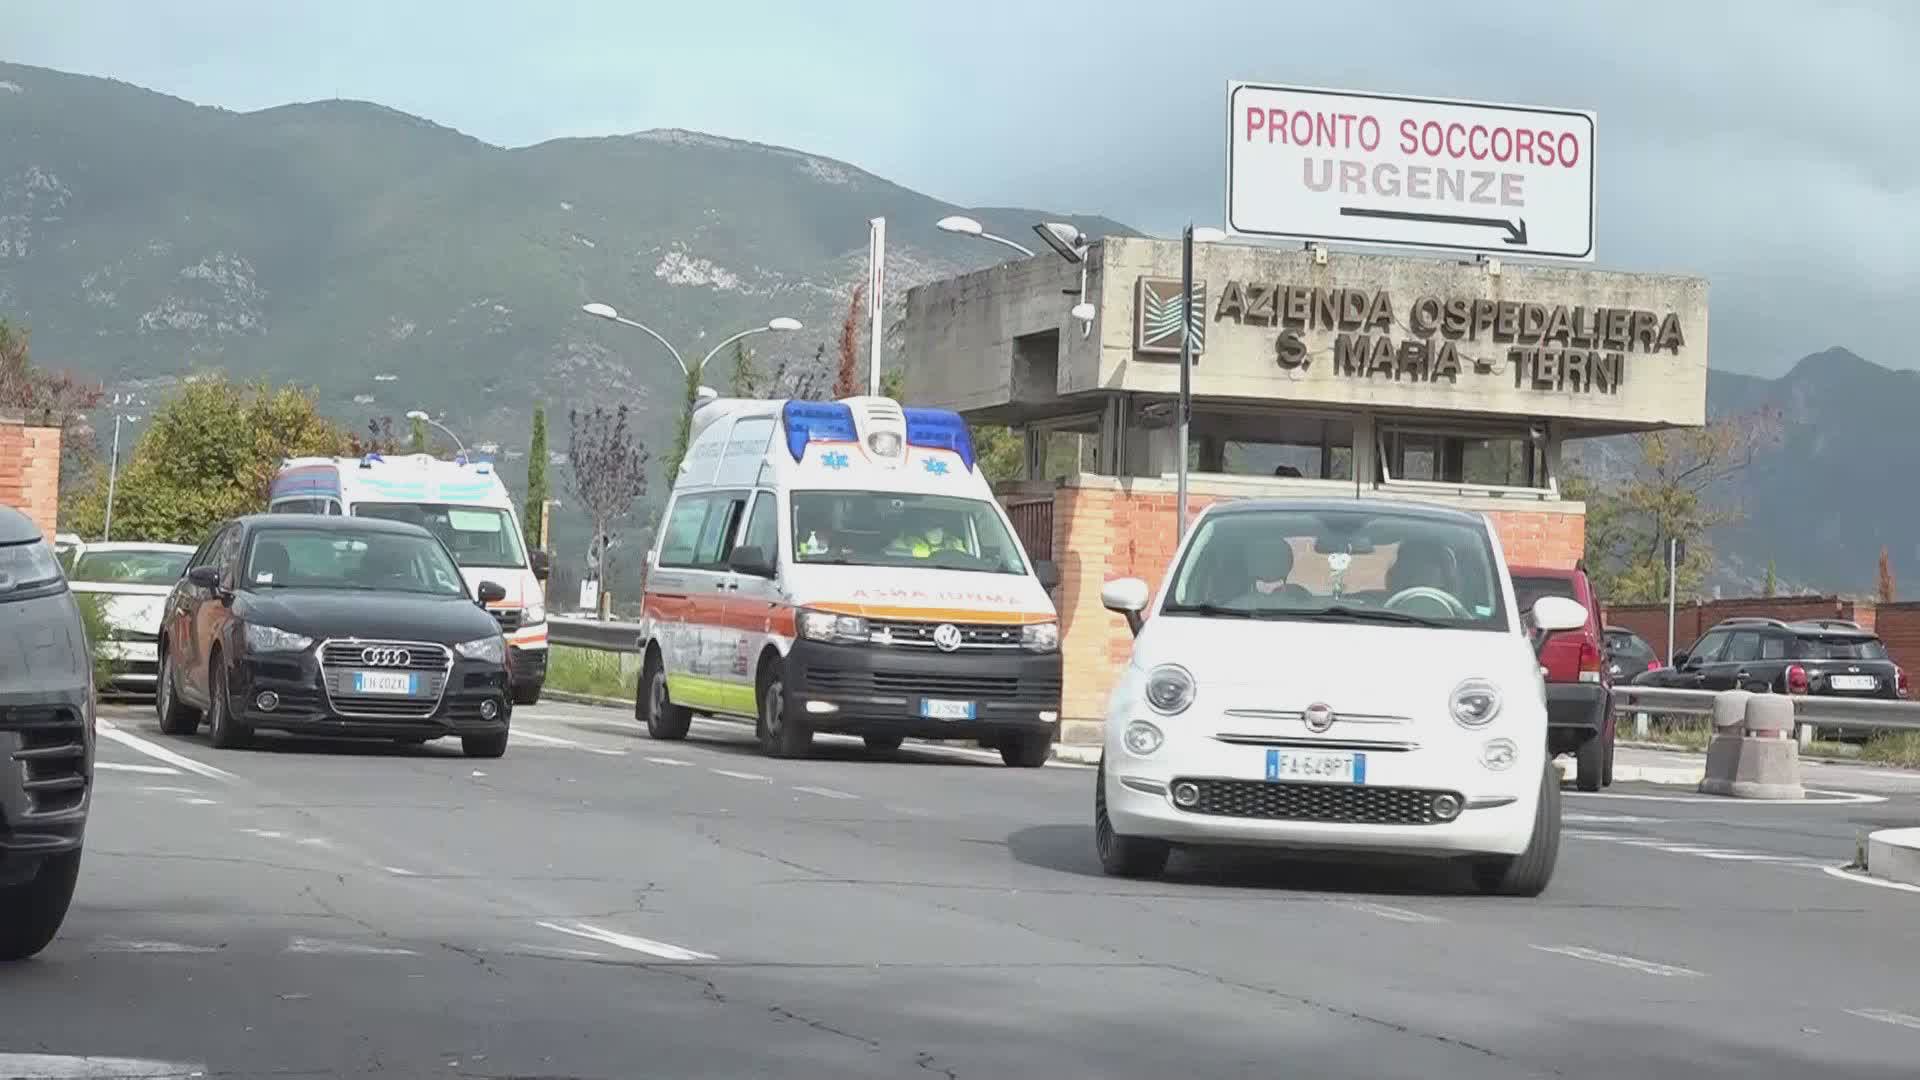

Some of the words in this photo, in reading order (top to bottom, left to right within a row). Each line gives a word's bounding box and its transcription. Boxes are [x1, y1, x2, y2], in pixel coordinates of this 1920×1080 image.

[1246, 106, 1381, 151] PRONTO
[1399, 118, 1580, 168] SOCCORSO
[1303, 157, 1526, 207] URGENZE
[1214, 279, 1397, 333] AZIENDA
[1409, 295, 1686, 355] OSPEDALIERA
[1275, 328, 1312, 371] S.
[1333, 333, 1463, 385] MARIA
[1507, 346, 1625, 394] TERNI
